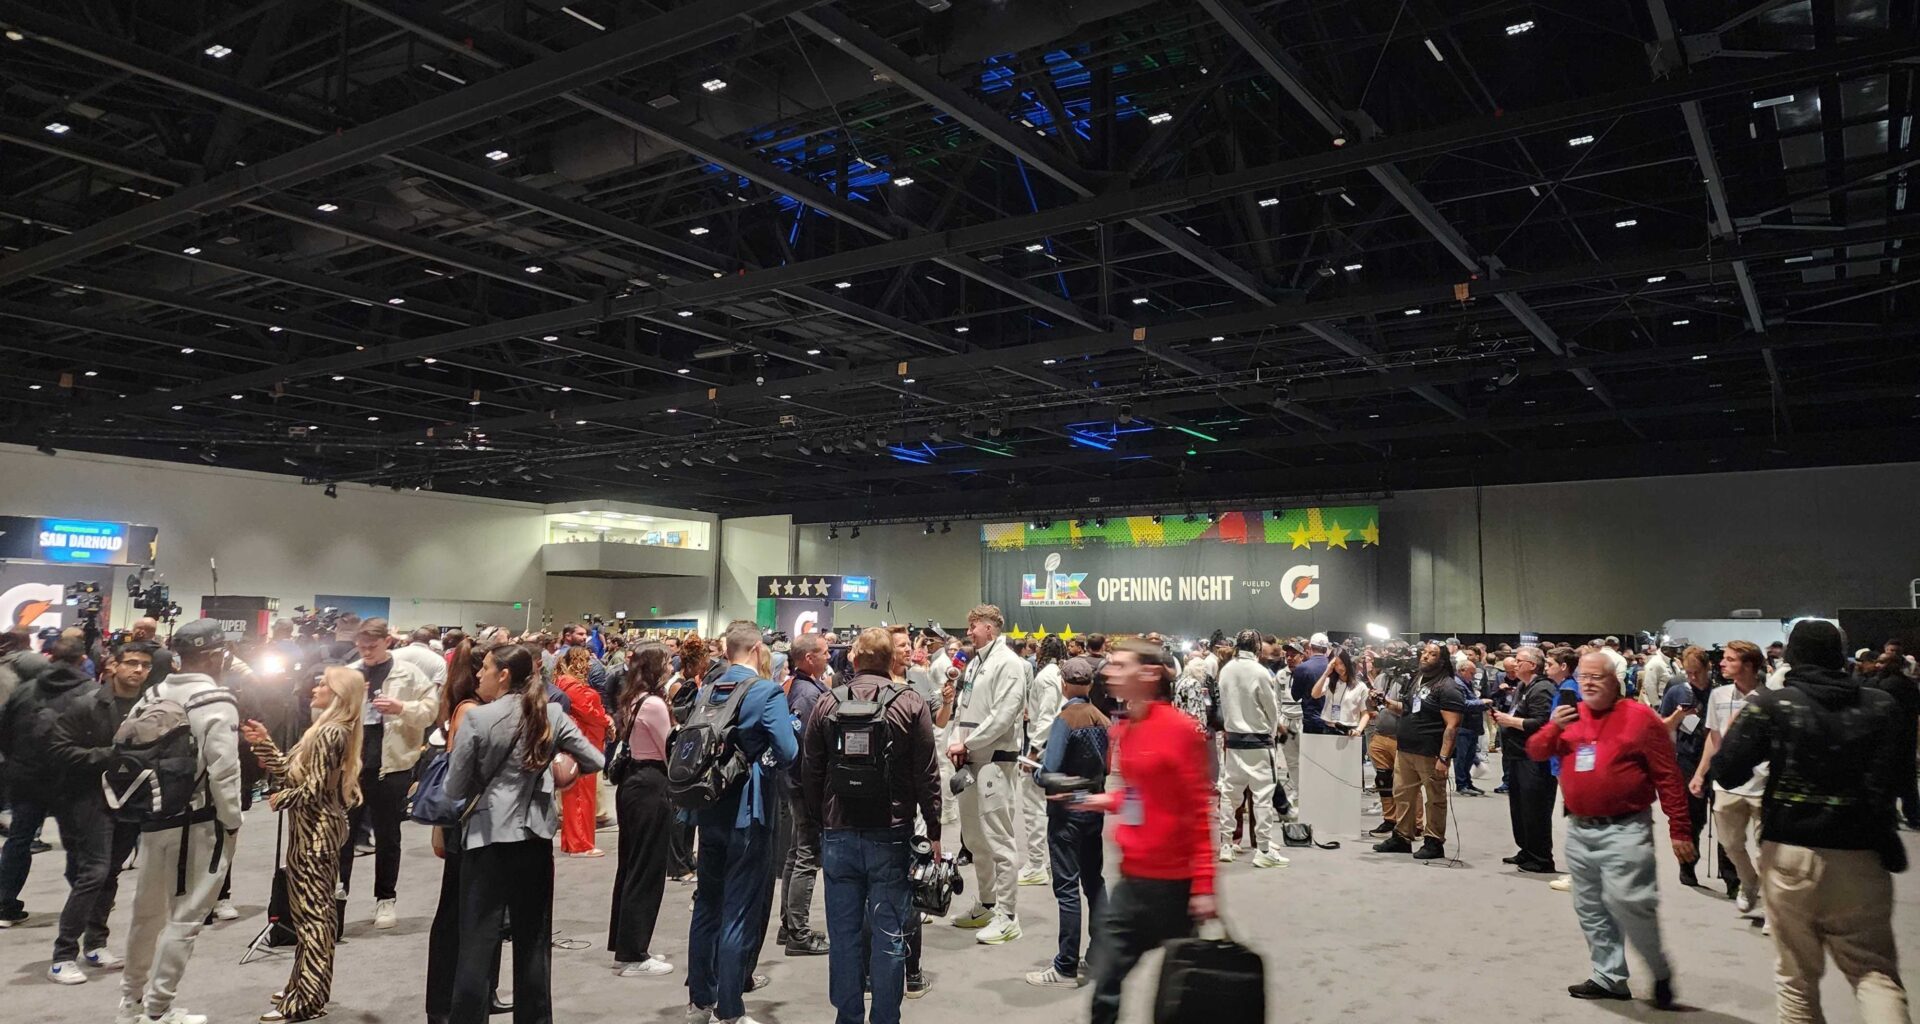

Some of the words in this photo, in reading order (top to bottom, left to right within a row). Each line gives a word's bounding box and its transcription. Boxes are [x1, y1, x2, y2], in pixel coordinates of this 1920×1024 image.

[40, 531, 67, 547] SAM
[1097, 576, 1173, 602] OPENING
[1178, 575, 1234, 601] NIGHT
[1280, 564, 1320, 610] G
[219, 619, 247, 631] UPER
